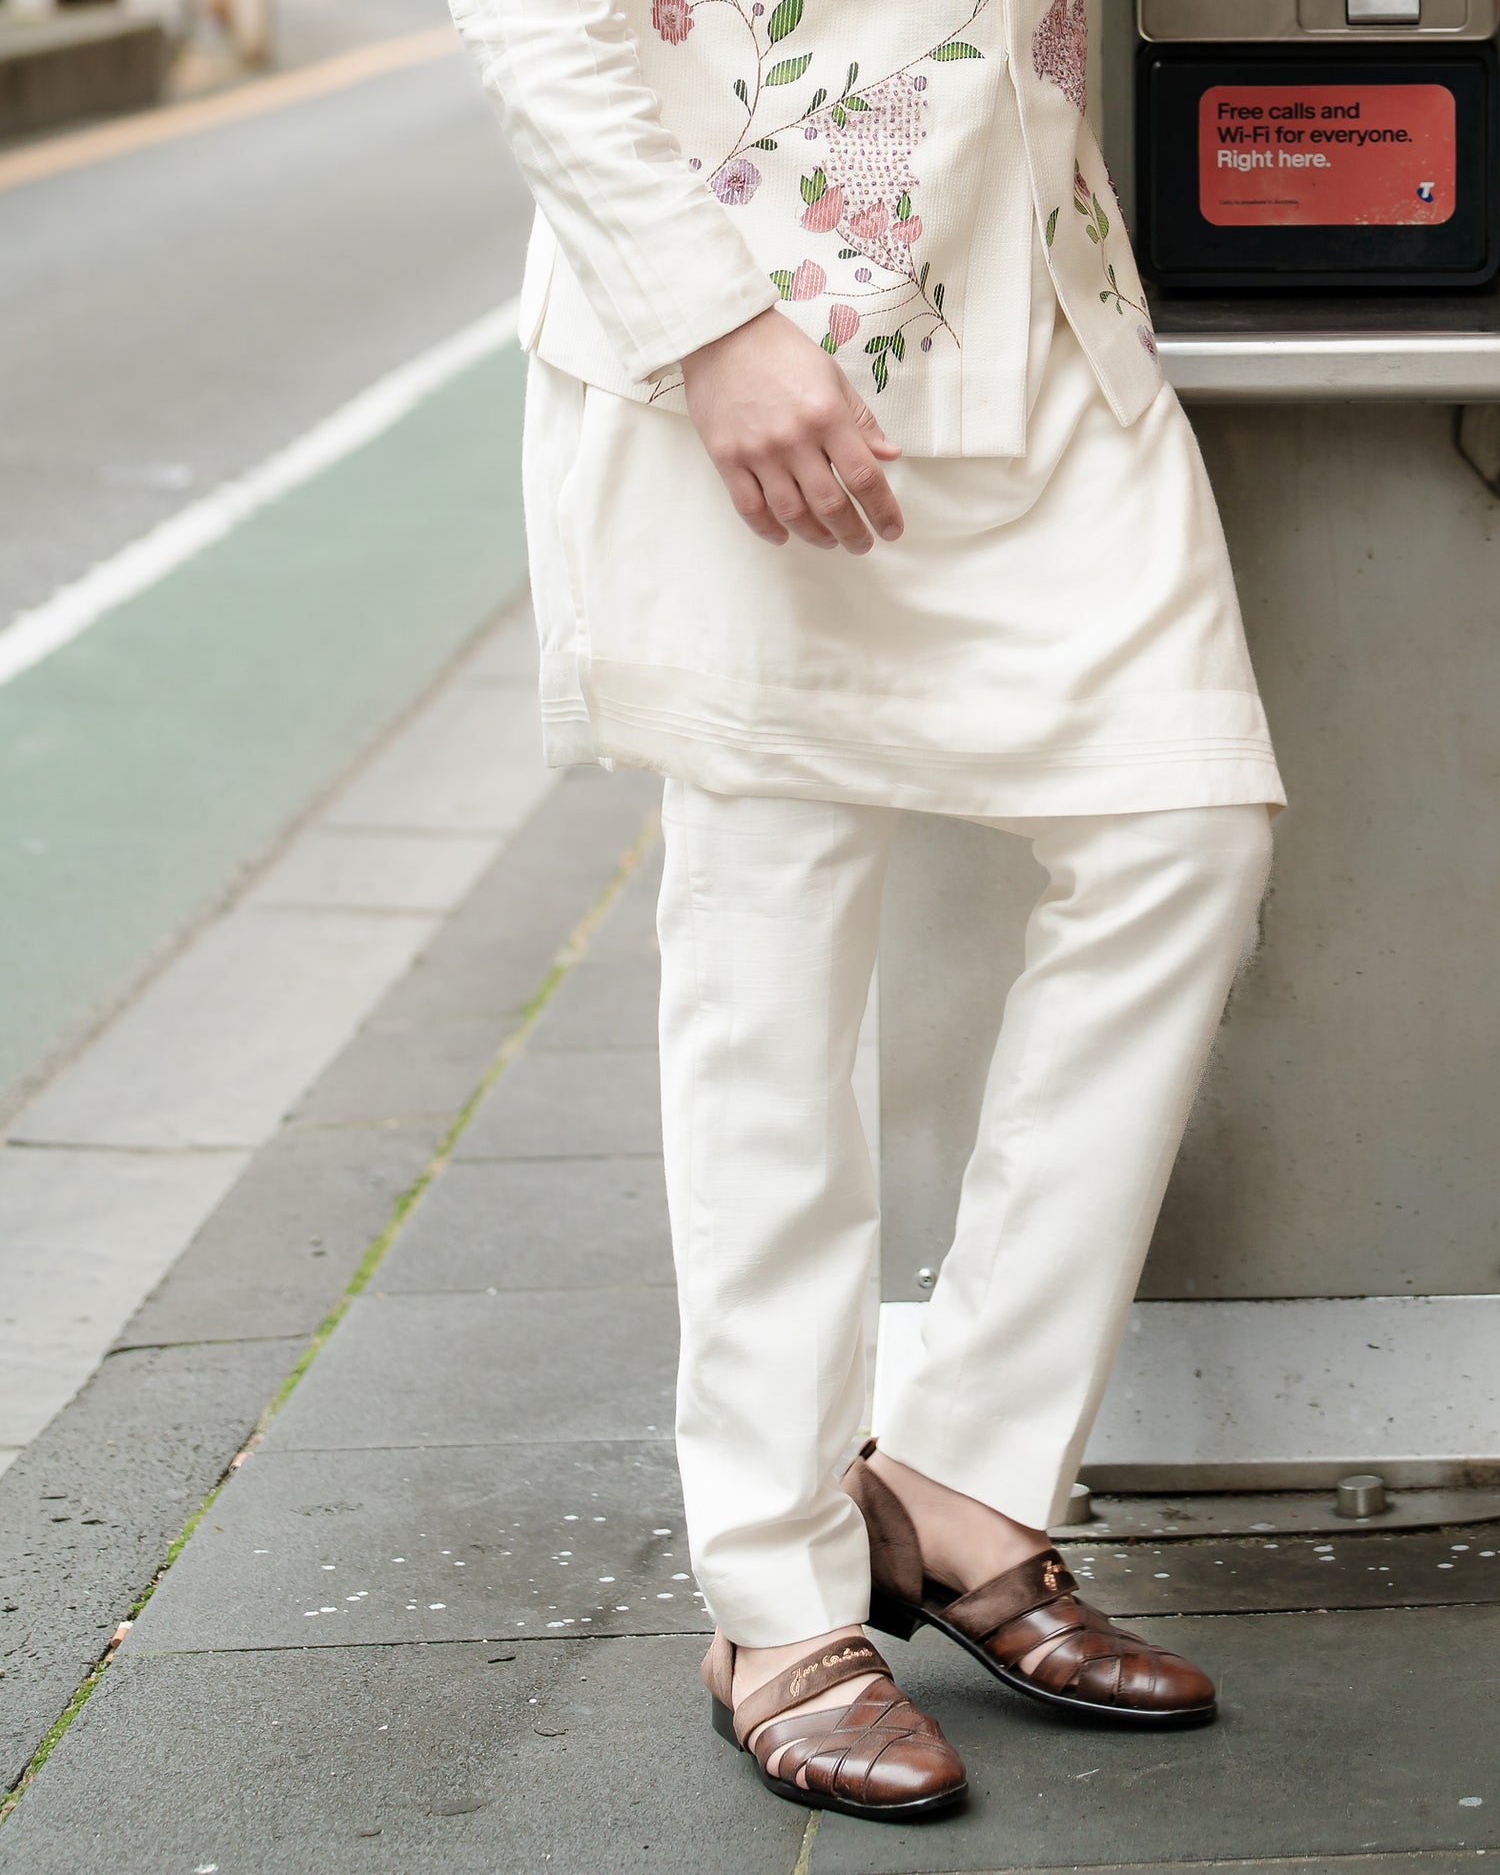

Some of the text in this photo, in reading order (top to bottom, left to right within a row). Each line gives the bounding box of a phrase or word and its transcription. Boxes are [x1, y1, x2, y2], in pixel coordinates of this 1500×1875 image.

[1217, 102, 1360, 120] Free calls and
[1217, 126, 1413, 147] Wi-Fi for everyone.
[1217, 149, 1331, 172] Right here.
